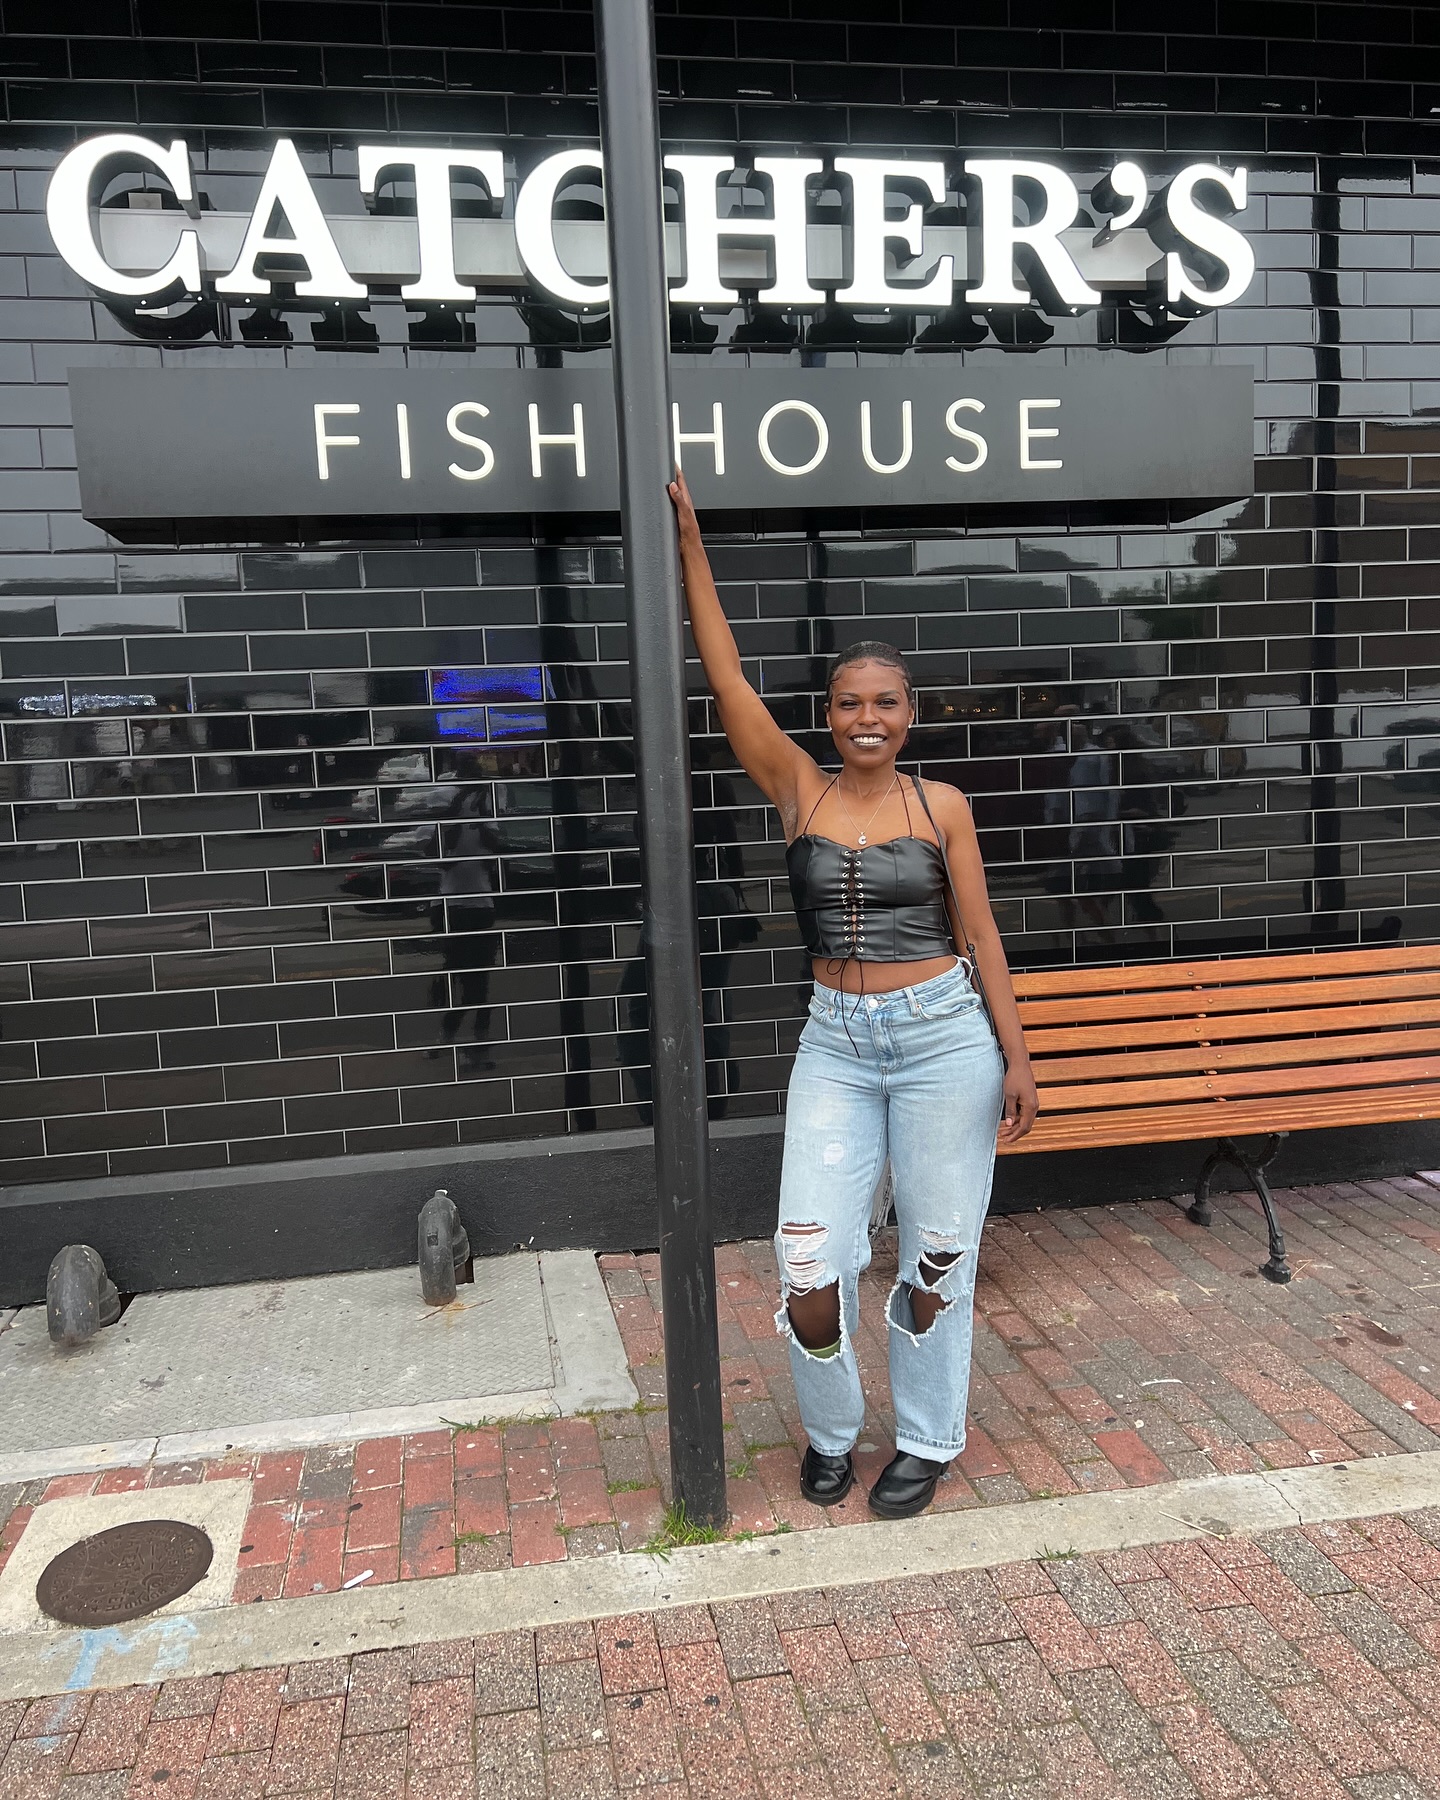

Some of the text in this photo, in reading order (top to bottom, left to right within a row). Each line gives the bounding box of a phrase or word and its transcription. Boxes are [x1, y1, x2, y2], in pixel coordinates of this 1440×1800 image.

[47, 135, 1254, 307] CATCHER'S
[313, 398, 1063, 480] FISH HOUSE
